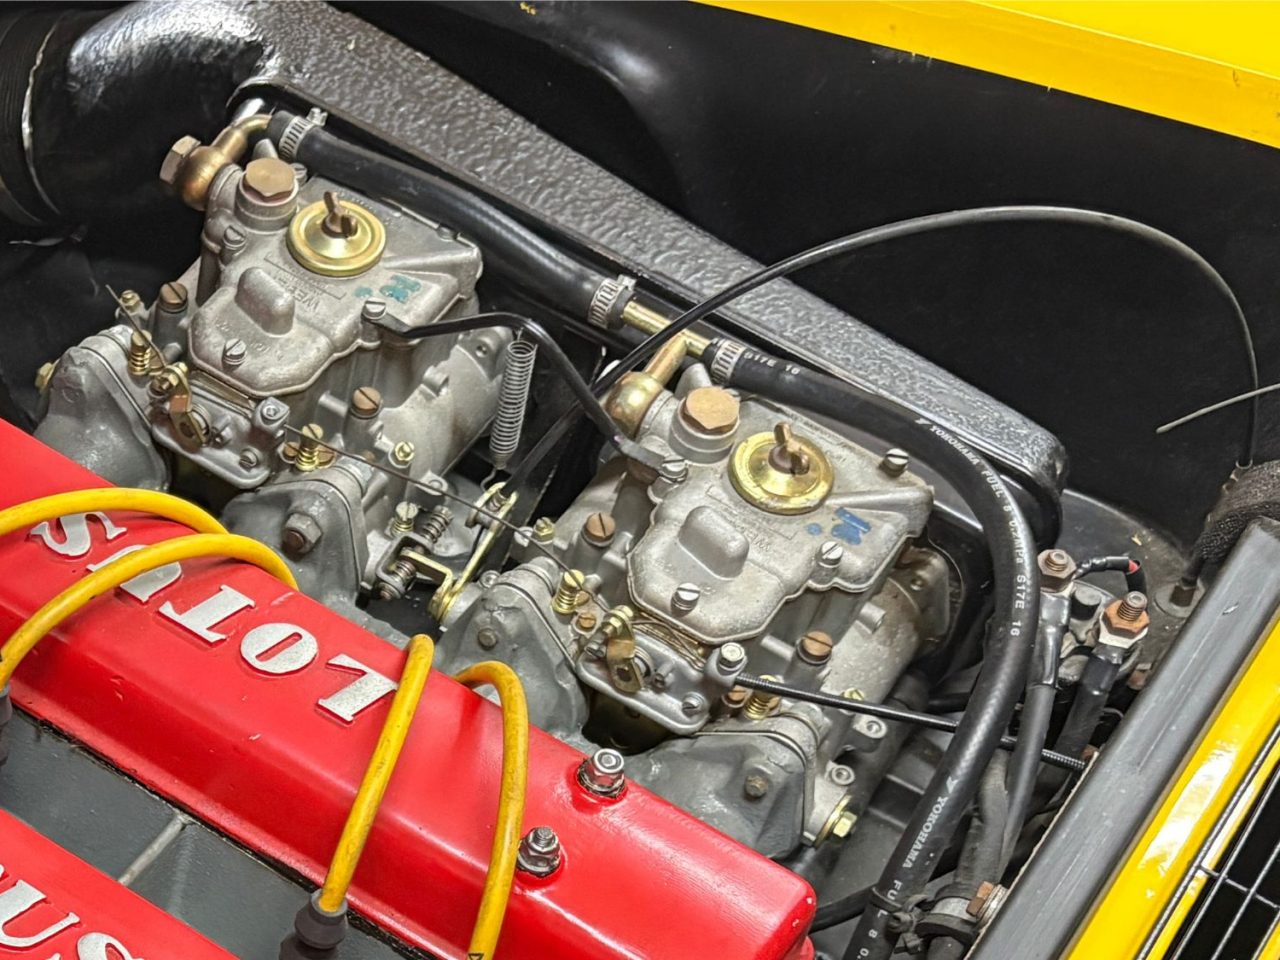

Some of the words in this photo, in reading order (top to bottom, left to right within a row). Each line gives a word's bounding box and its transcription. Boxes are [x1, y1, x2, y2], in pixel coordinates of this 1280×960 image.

[929, 424, 981, 466] YOKOHAMA
[981, 470, 1003, 499] FUEL
[1014, 575, 1027, 610] S17E
[1009, 620, 1022, 637] 16
[902, 796, 949, 869] YOKOHAMA
[876, 880, 903, 918] FUL
